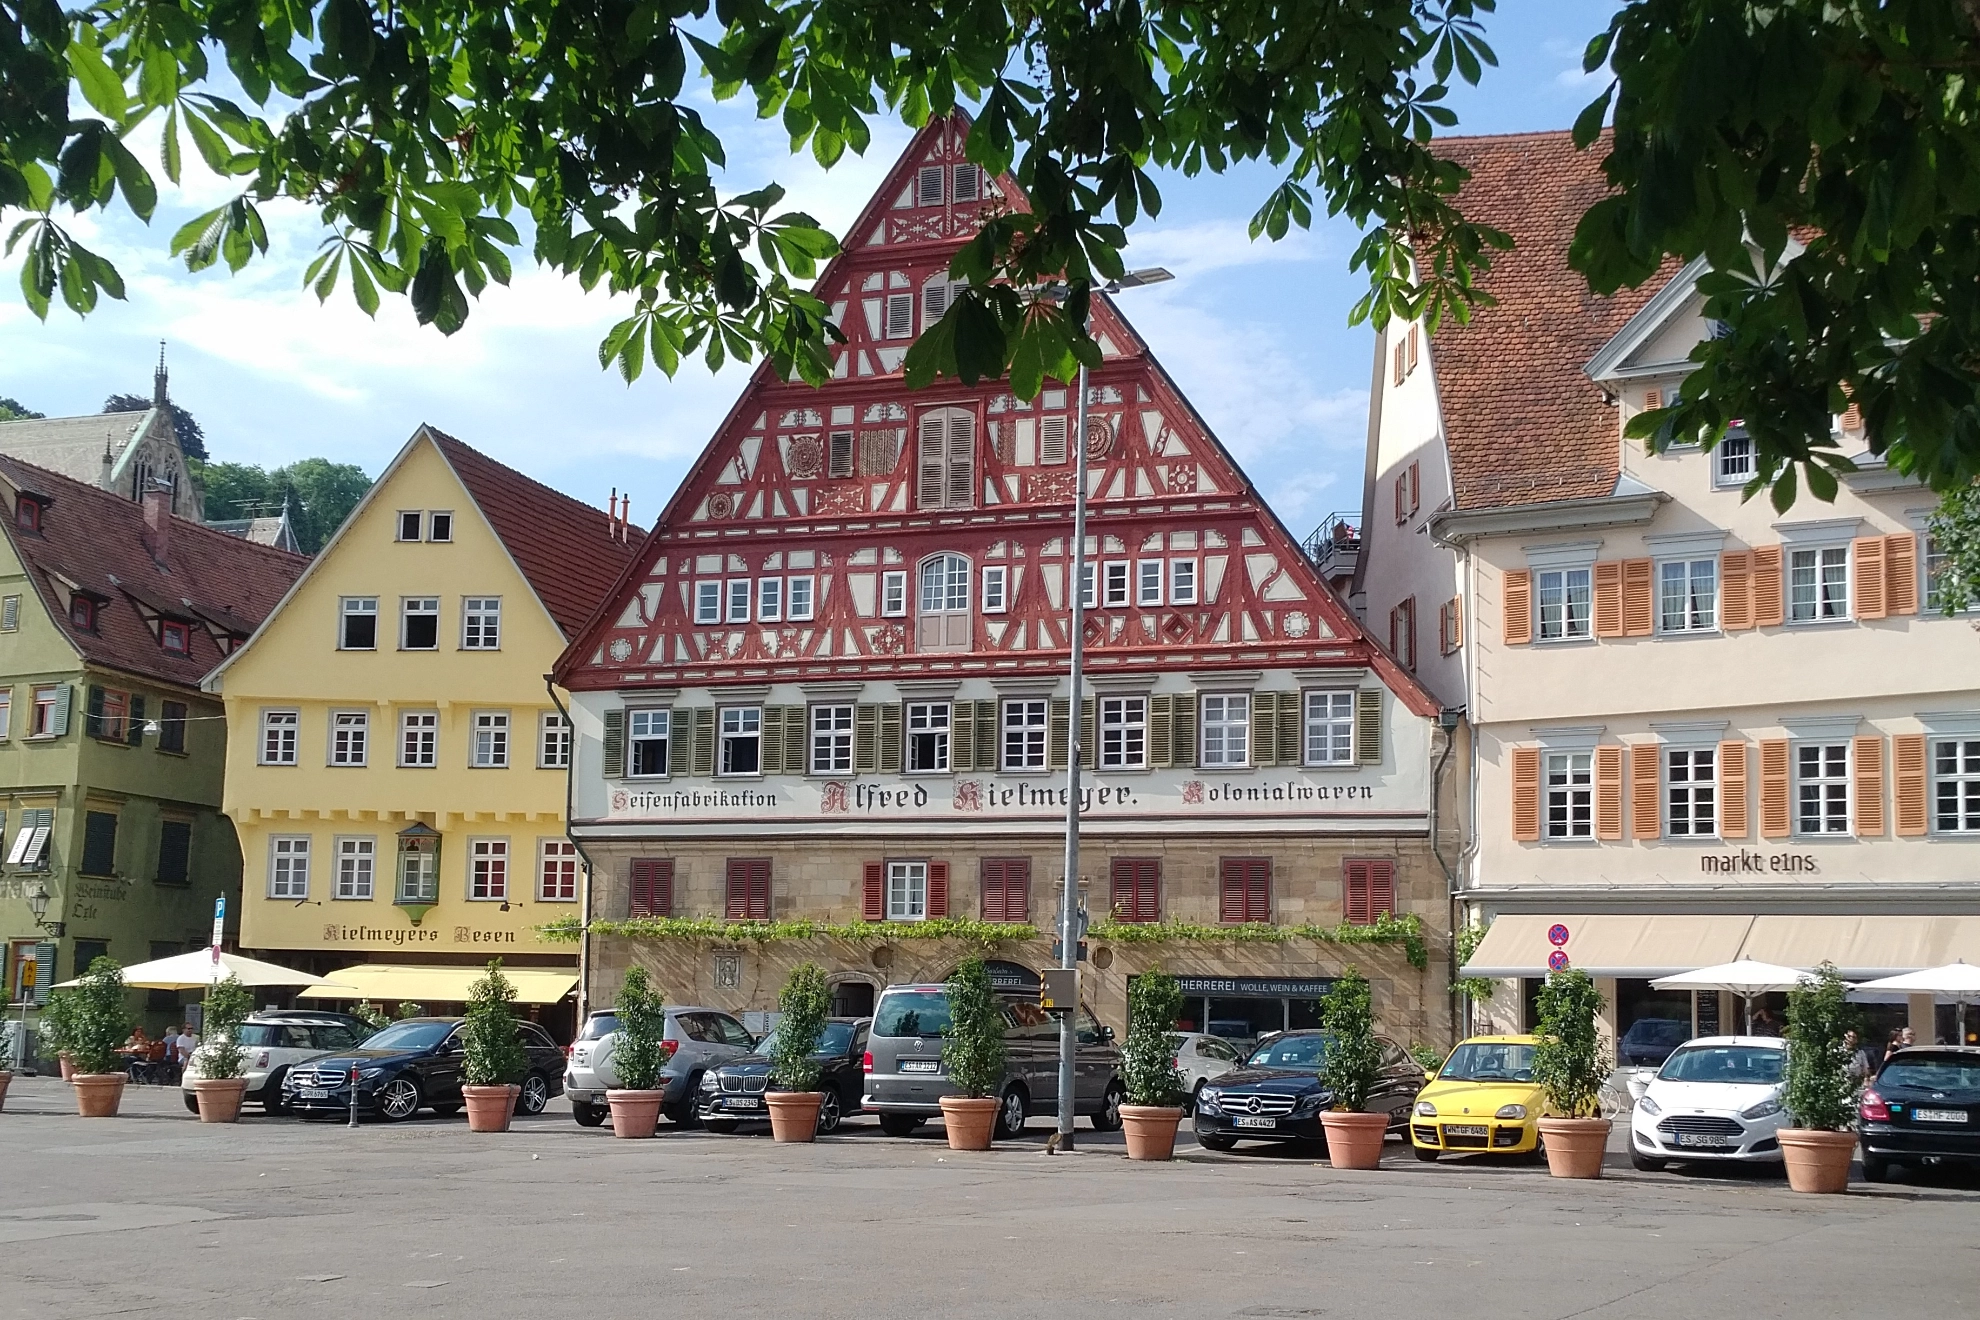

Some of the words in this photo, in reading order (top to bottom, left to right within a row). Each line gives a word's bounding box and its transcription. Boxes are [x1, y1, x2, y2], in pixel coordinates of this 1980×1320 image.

[611, 789, 777, 812] Seifenfabrikation
[821, 780, 928, 814] Alfred
[1182, 780, 1373, 804] Kolonialwaren
[1701, 848, 1763, 871] markt
[323, 924, 439, 946] Kielmeyers
[453, 925, 515, 943] Besen
[1270, 983, 1290, 992] WEIN
[1291, 984, 1298, 992] &
[1299, 984, 1328, 993] KAFFEE
[1259, 1119, 1274, 1127] 4427
[1680, 1135, 1691, 1143] ES
[1696, 1136, 1707, 1144] SG
